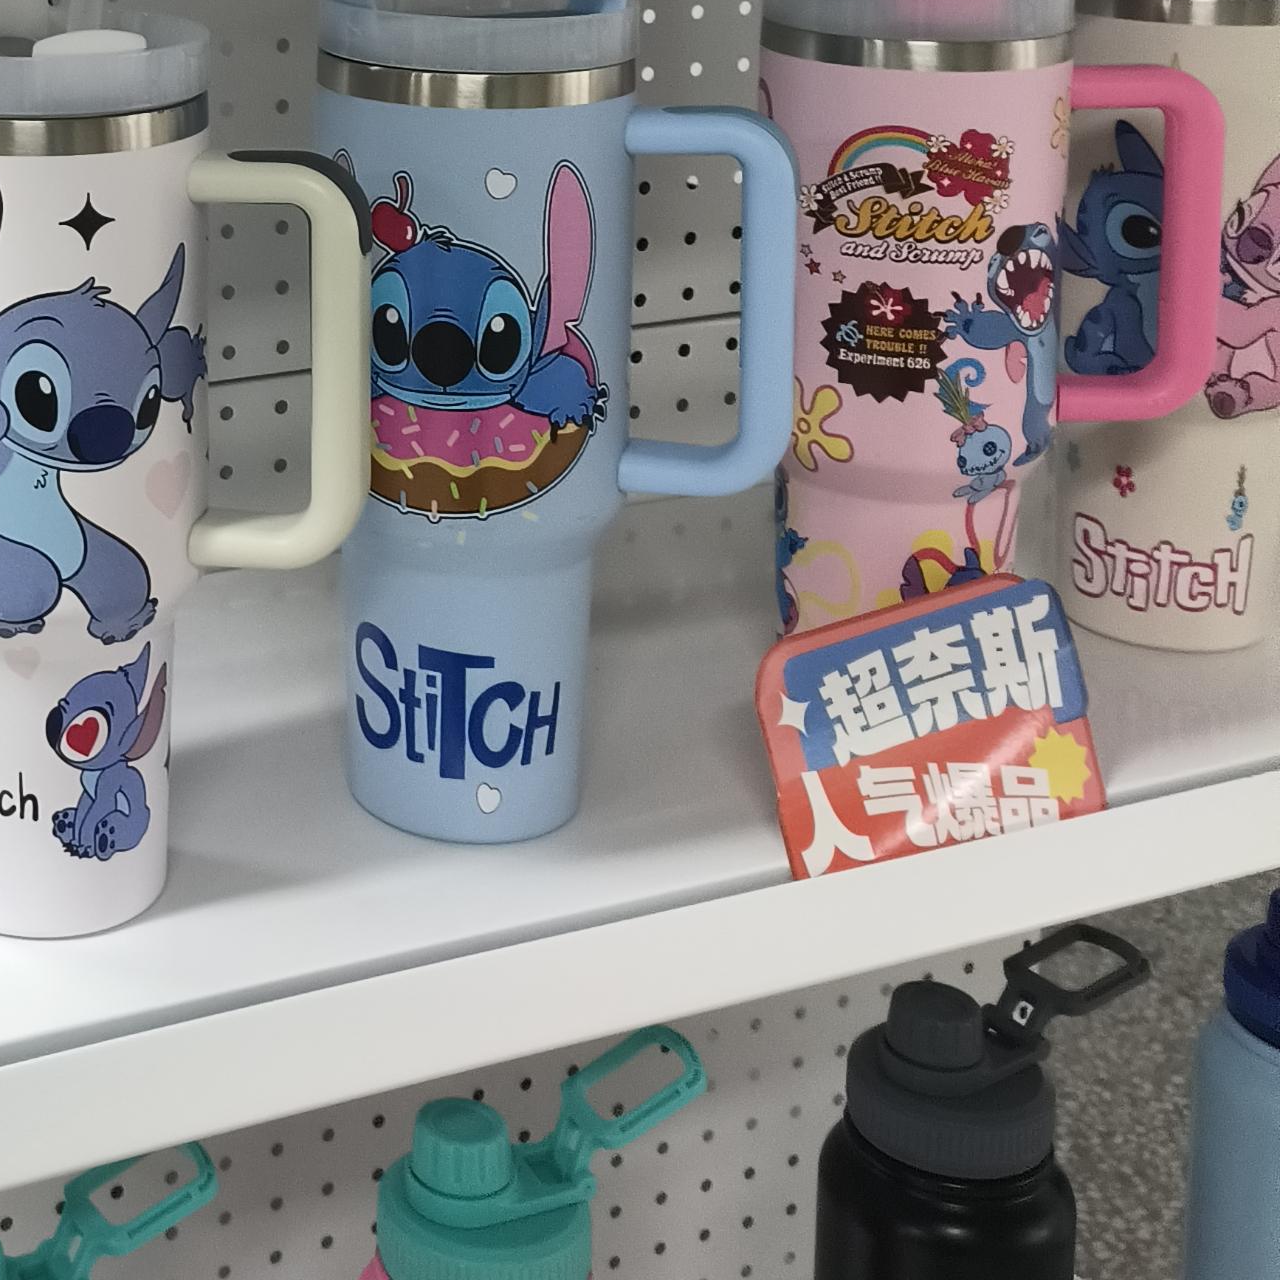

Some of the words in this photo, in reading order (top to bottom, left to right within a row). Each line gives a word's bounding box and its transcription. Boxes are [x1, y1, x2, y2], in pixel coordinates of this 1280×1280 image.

[835, 195, 995, 244] Stitch
[840, 241, 889, 260] and
[888, 241, 984, 270] Scrump
[865, 324, 895, 338] HERE
[898, 328, 937, 341] COMES
[865, 338, 915, 354] TROUBLE
[838, 348, 905, 369] Experiment
[907, 357, 931, 370] 626
[818, 594, 1064, 768] 超奈斯
[800, 761, 1061, 878] 人气爆品
